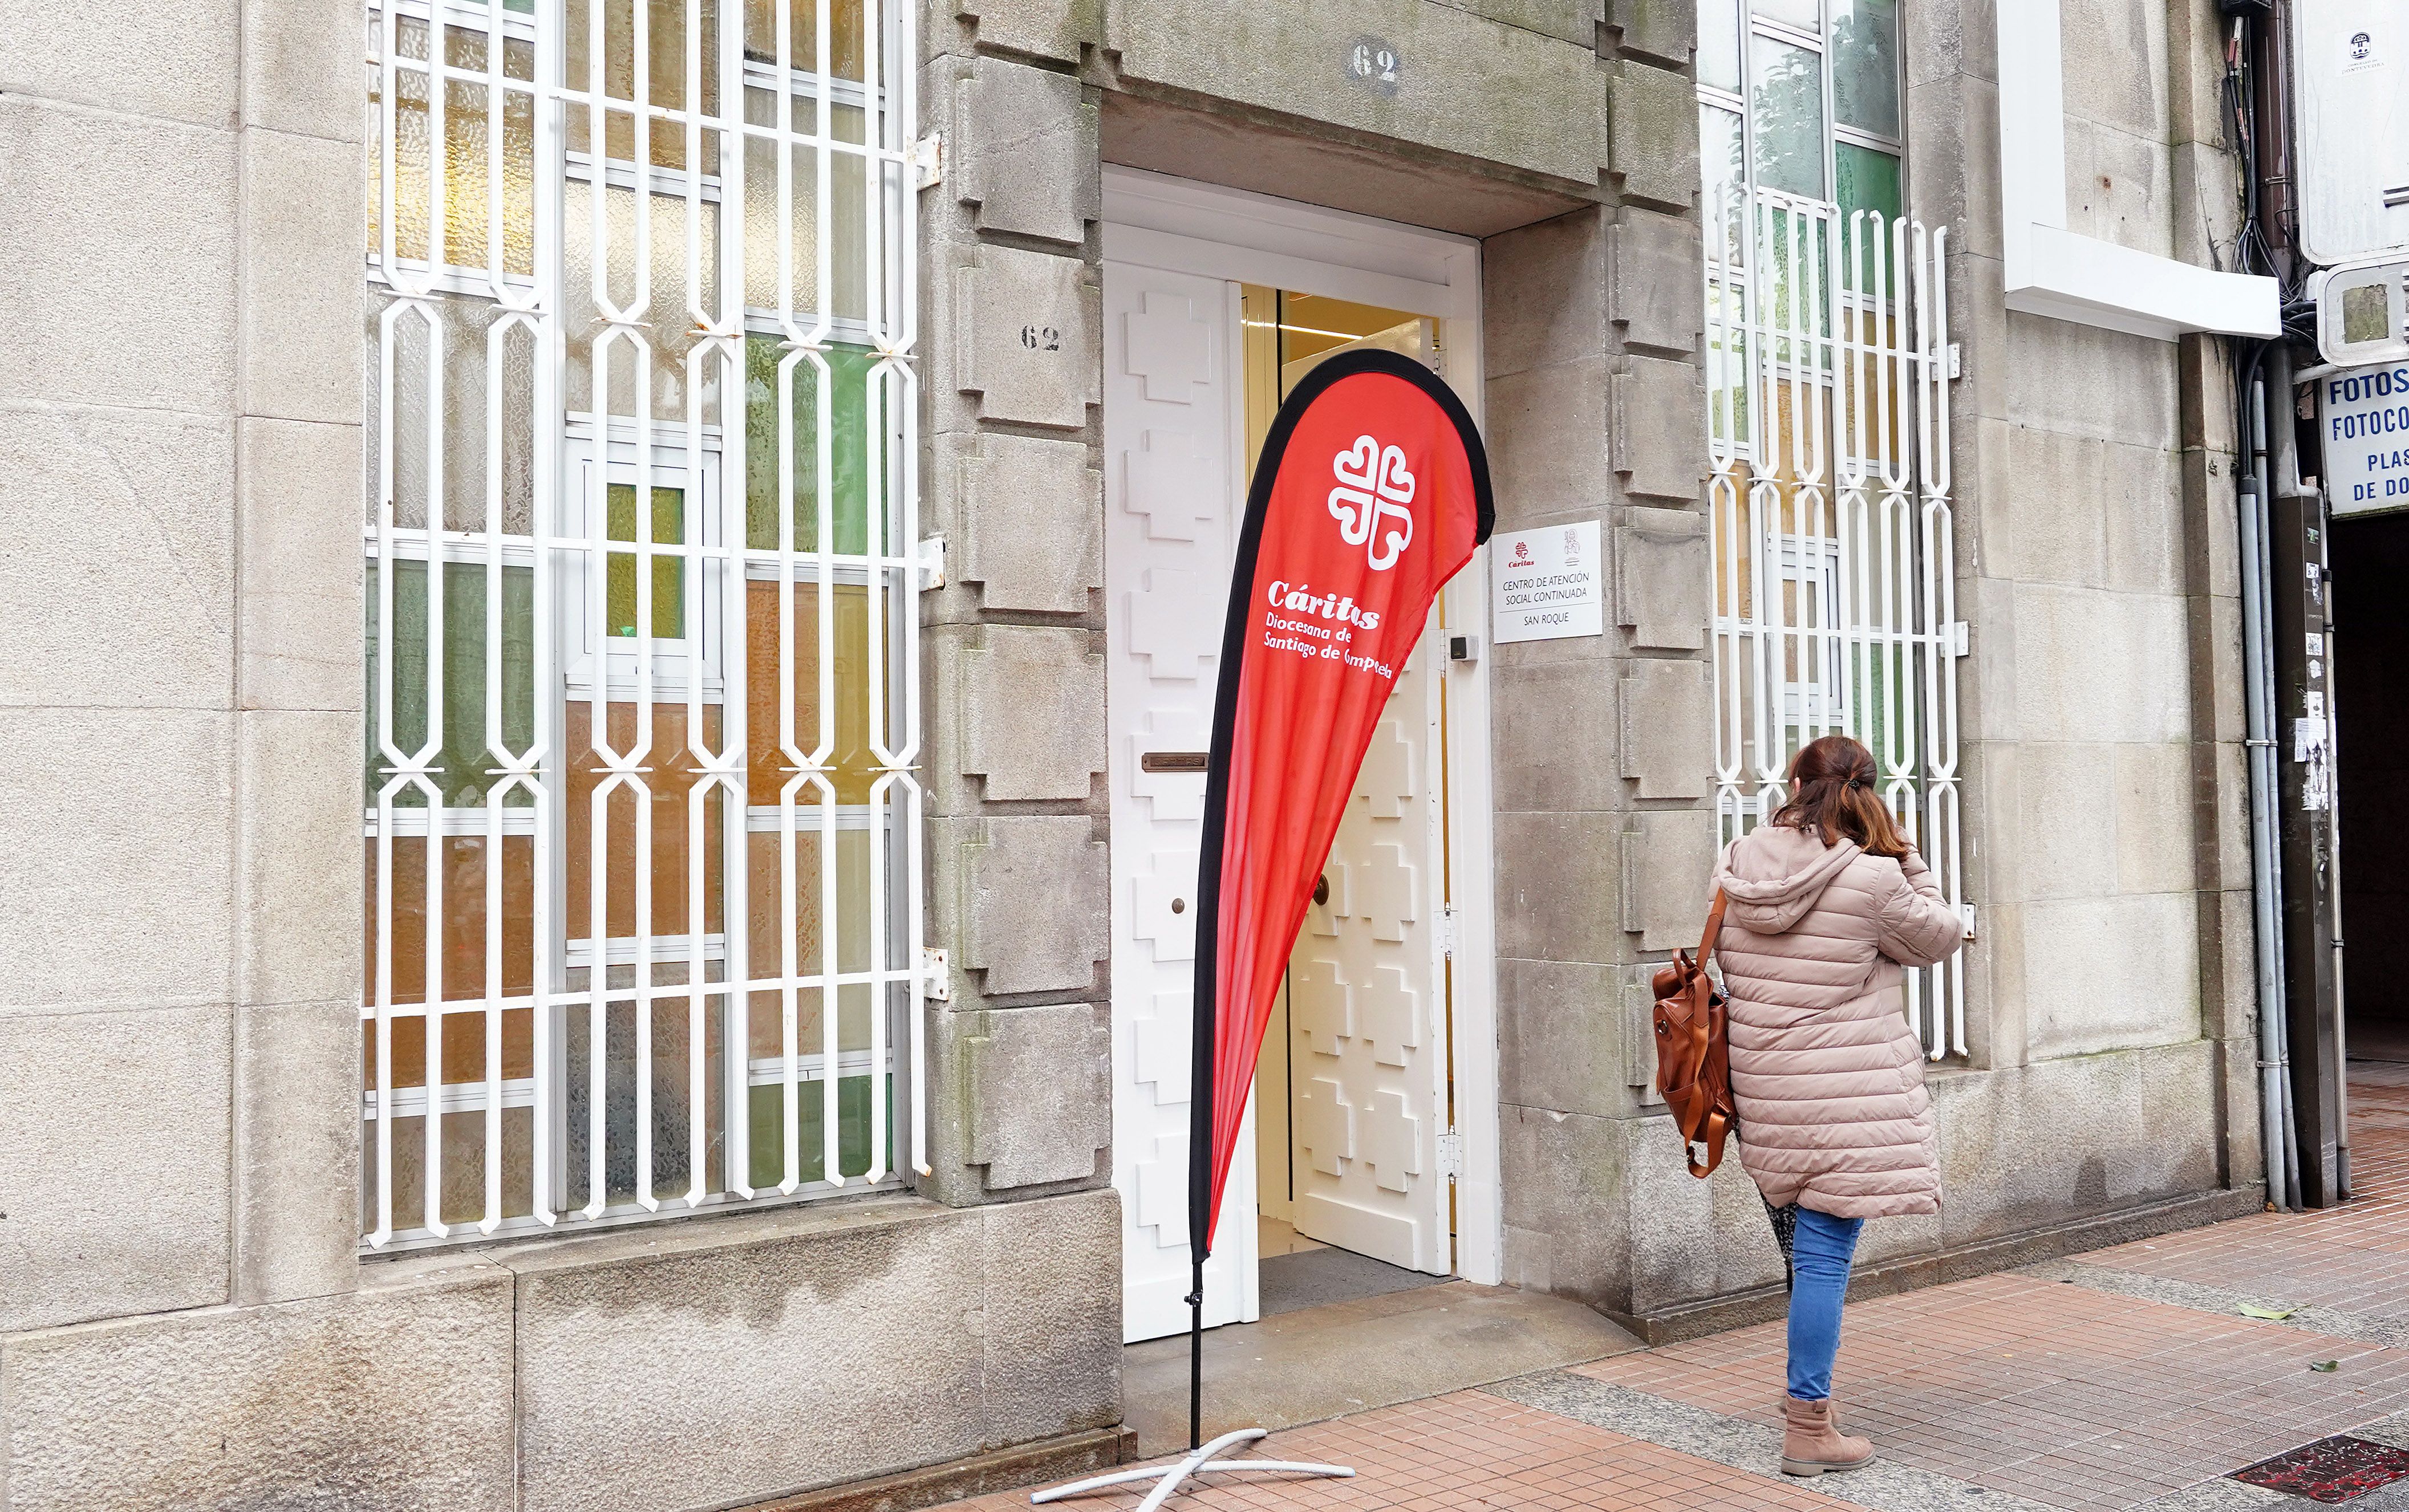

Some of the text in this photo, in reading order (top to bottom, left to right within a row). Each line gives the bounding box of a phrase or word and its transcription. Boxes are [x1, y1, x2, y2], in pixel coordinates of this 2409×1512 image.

[1353, 44, 1395, 82] 62
[2342, 63, 2384, 74] PONTEVEDRA
[1021, 325, 1059, 351] 62
[2329, 368, 2409, 404] FOTOS
[2333, 406, 2409, 441] FOTOCO
[2354, 477, 2409, 501] DE DO
[1503, 570, 1589, 591] CENTRO DE ATENCIÓN
[1268, 580, 1380, 630] Cáritas
[1506, 587, 1587, 605] SOCIAL CONTINUADA
[1266, 611, 1352, 643] Diocesana de
[1524, 612, 1570, 626] SAN ROQUE
[1264, 631, 1317, 659] Santiago
[1320, 644, 1340, 660] de
